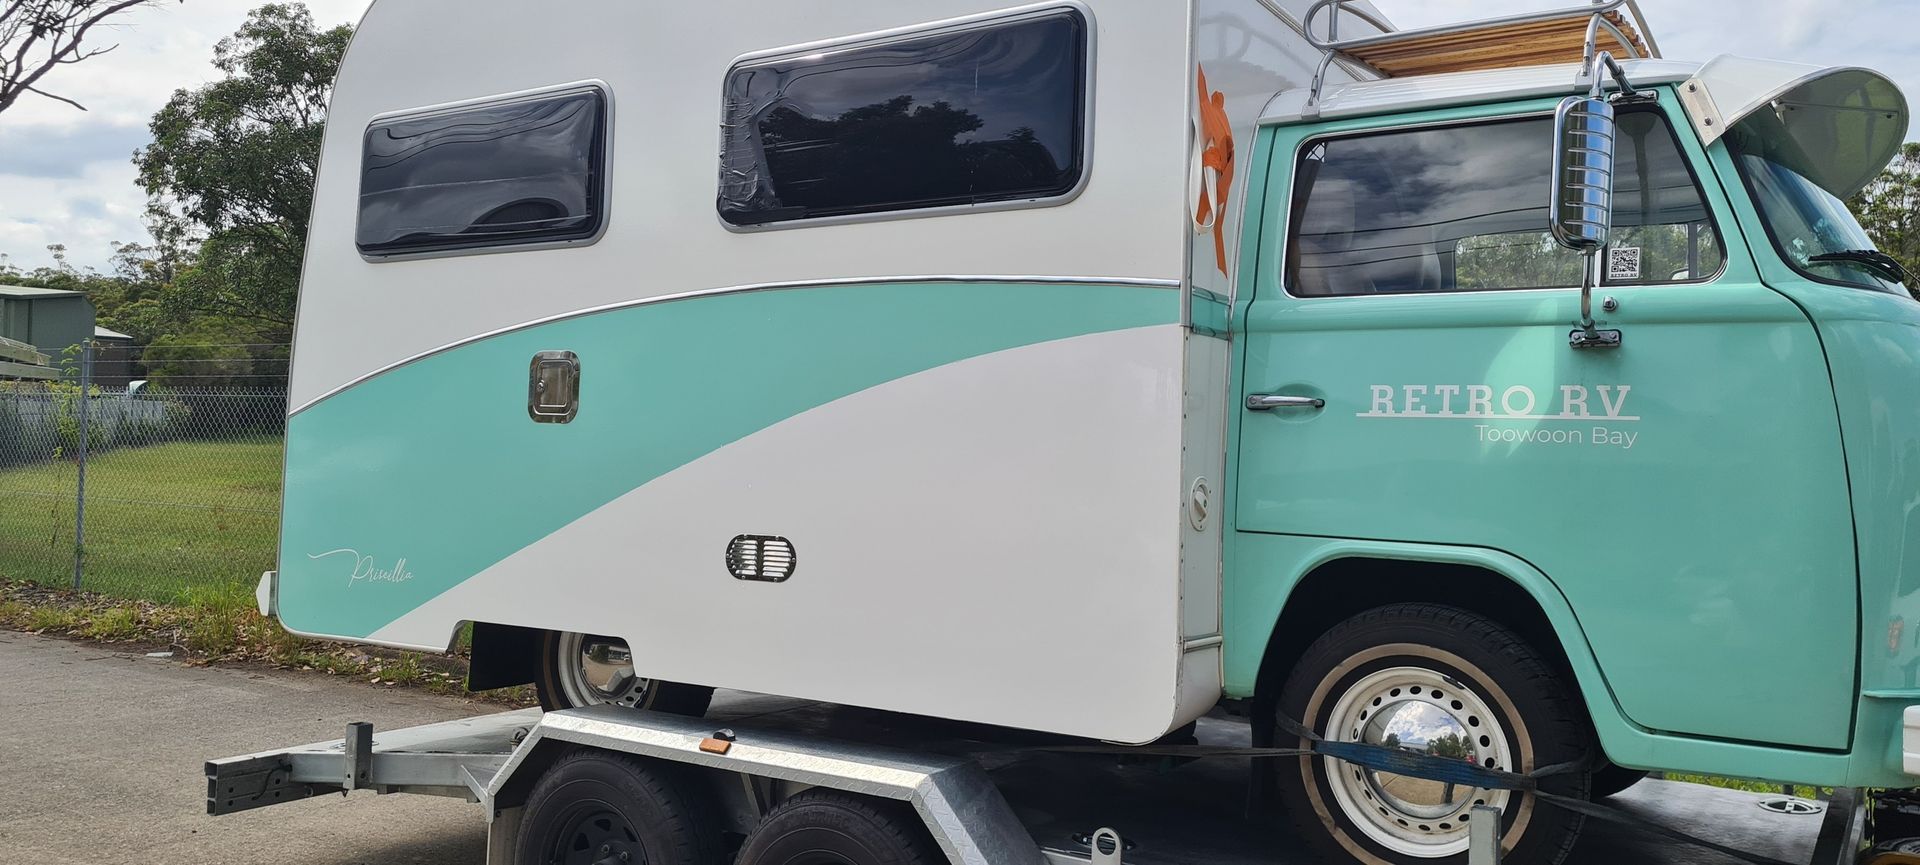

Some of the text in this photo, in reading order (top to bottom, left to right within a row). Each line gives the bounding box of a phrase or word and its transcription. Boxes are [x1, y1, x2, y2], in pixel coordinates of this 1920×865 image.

[1368, 384, 1631, 417] RETRO RV
[1474, 424, 1638, 449] Toowoon Bay
